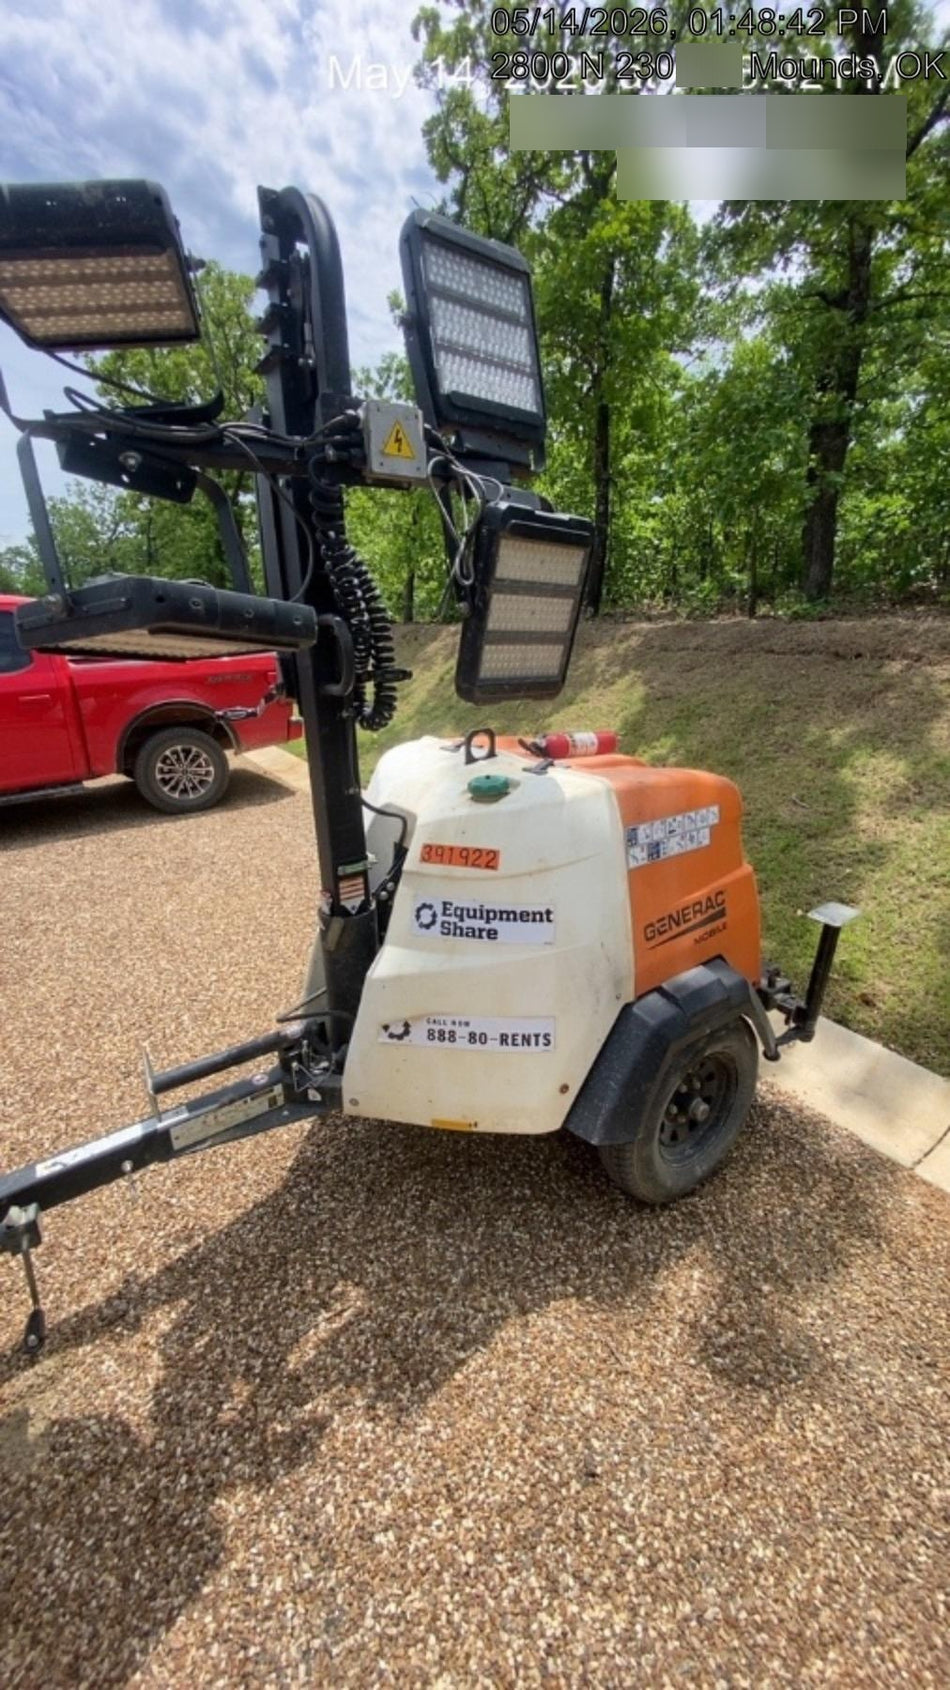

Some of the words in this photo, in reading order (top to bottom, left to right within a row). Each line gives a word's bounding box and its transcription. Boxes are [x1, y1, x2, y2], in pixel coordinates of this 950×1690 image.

[421, 844, 498, 869] 391922
[441, 901, 554, 924] Equipment
[643, 890, 726, 942] GENERAC
[440, 920, 499, 940] Share
[427, 1028, 551, 1047] 888-80-RENTS
